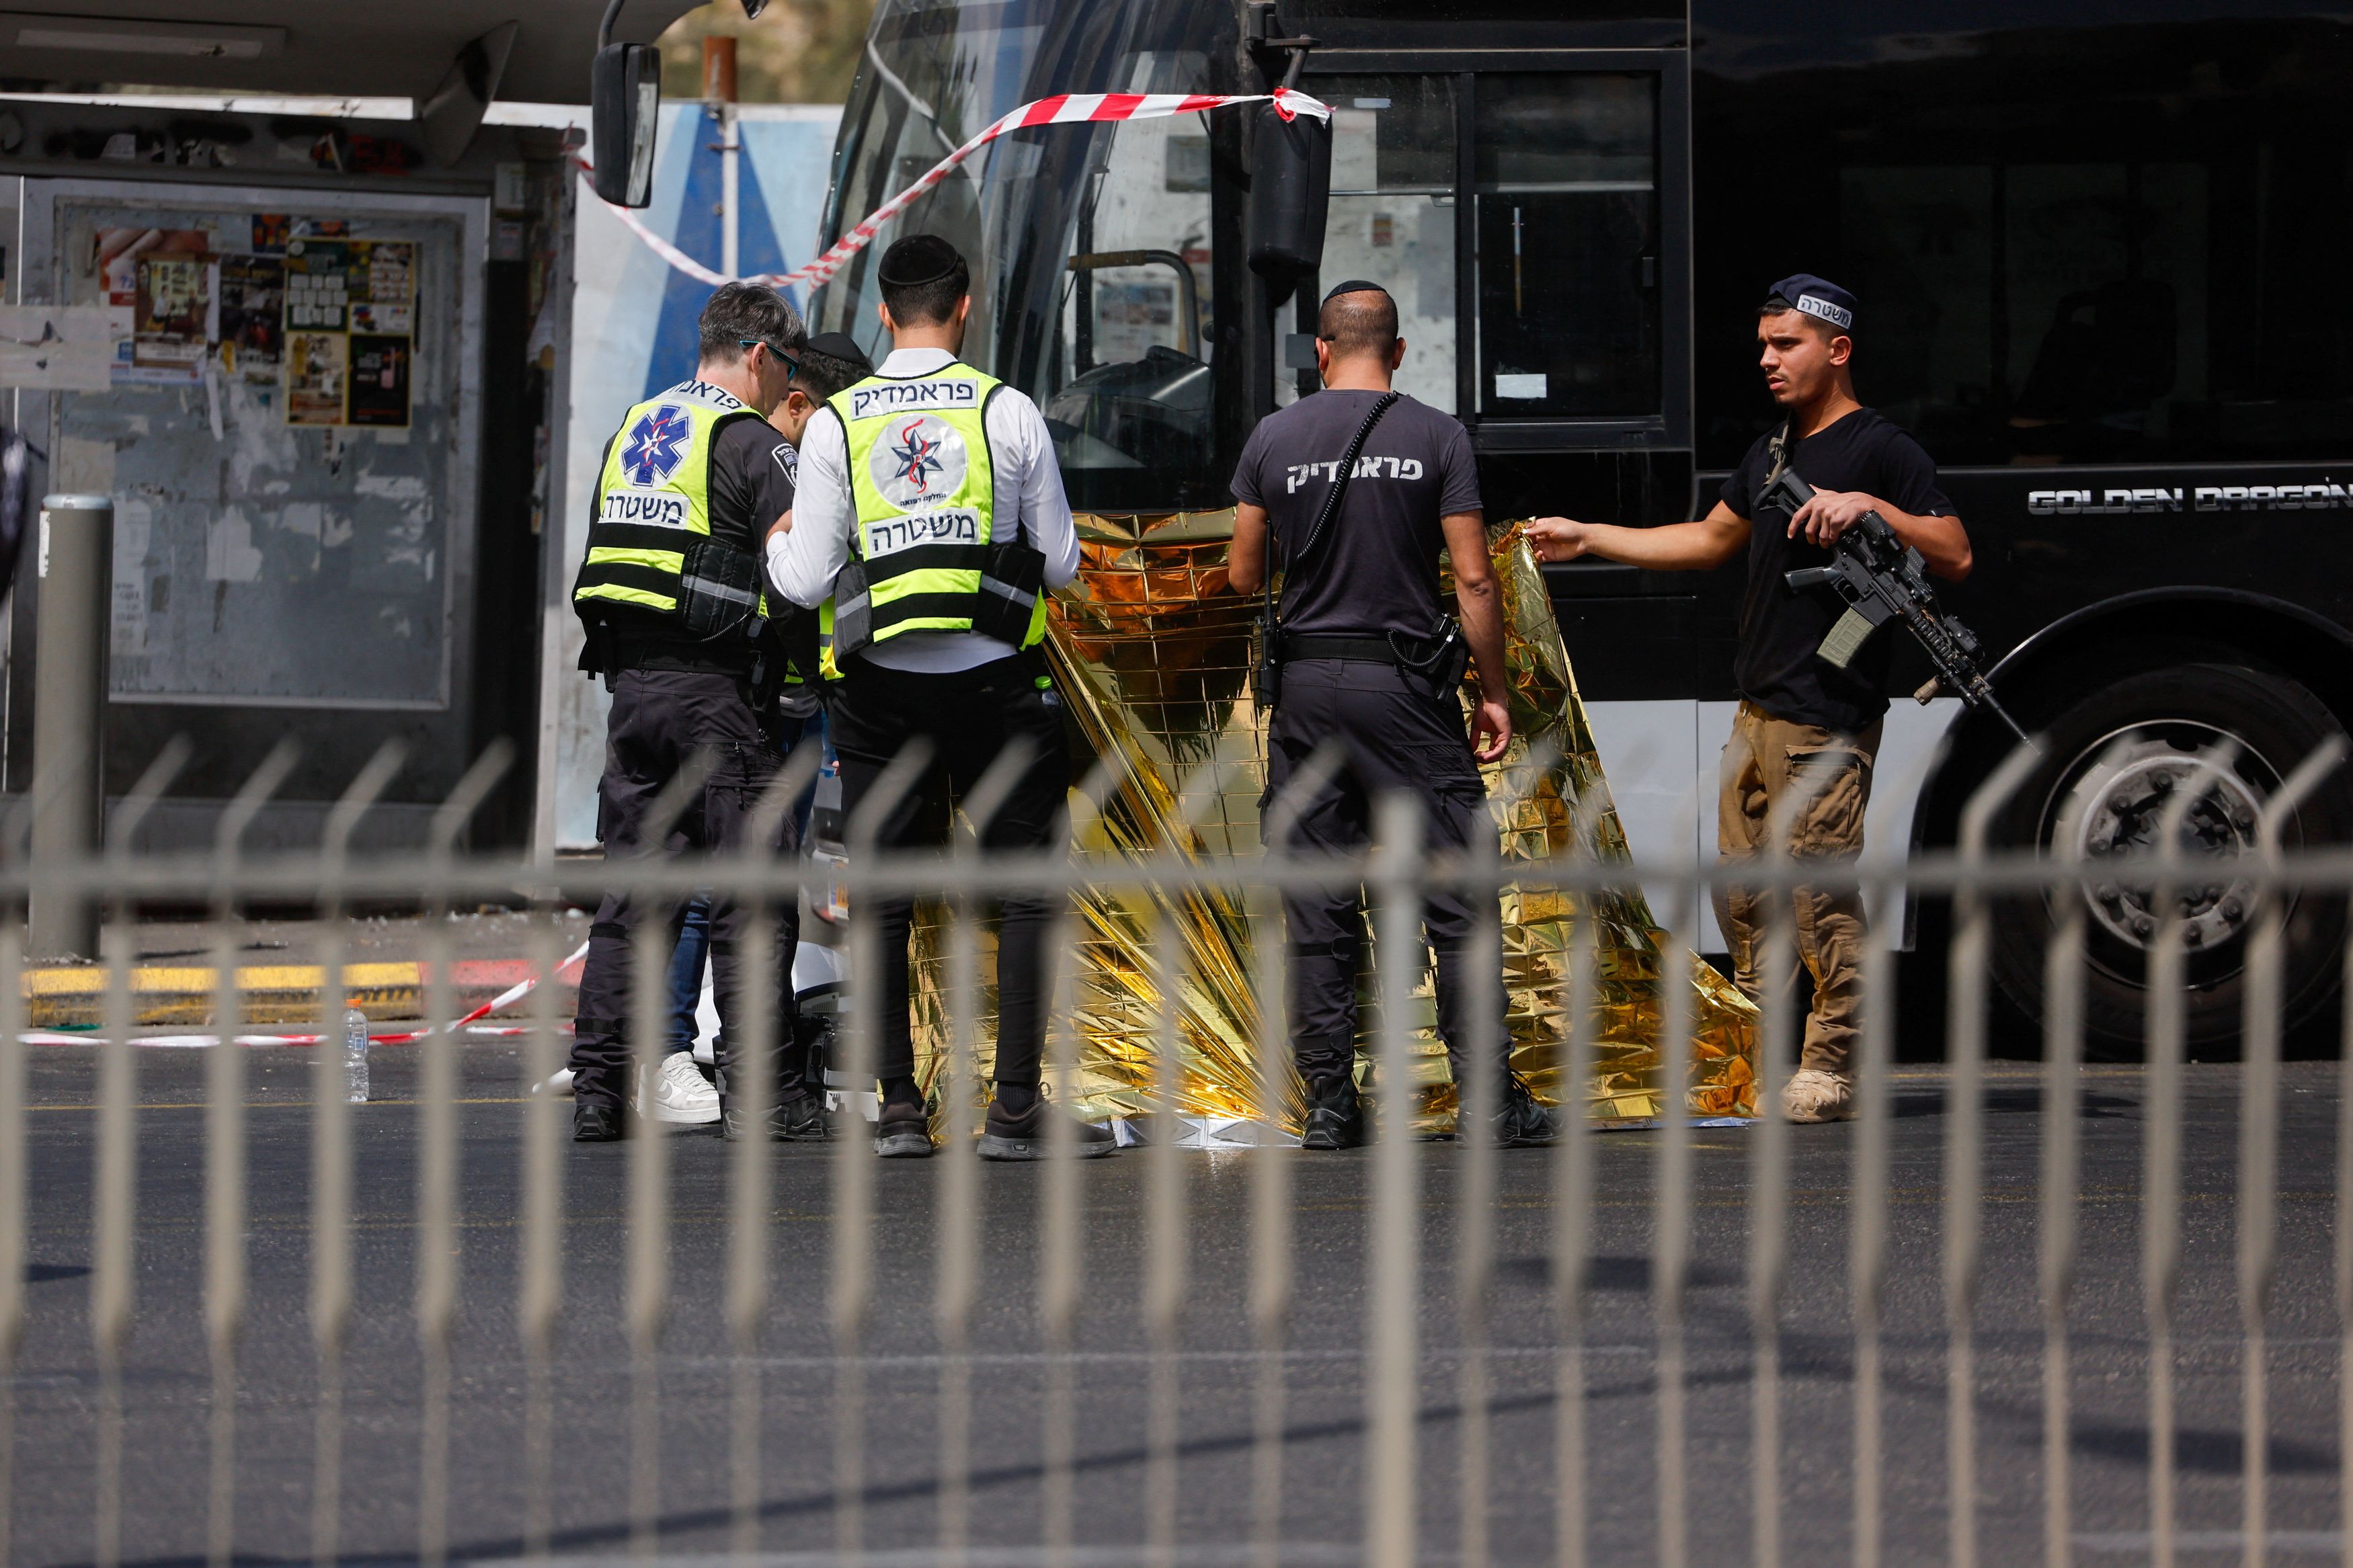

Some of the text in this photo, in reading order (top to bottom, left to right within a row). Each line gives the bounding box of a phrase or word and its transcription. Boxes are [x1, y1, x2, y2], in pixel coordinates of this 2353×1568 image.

[1802, 298, 1849, 325] משטרה
[854, 383, 973, 416] פראמדיק
[601, 495, 682, 524] משטרה
[2028, 484, 2353, 515] GOLDEN DRAGON
[872, 514, 975, 551] משטרה
